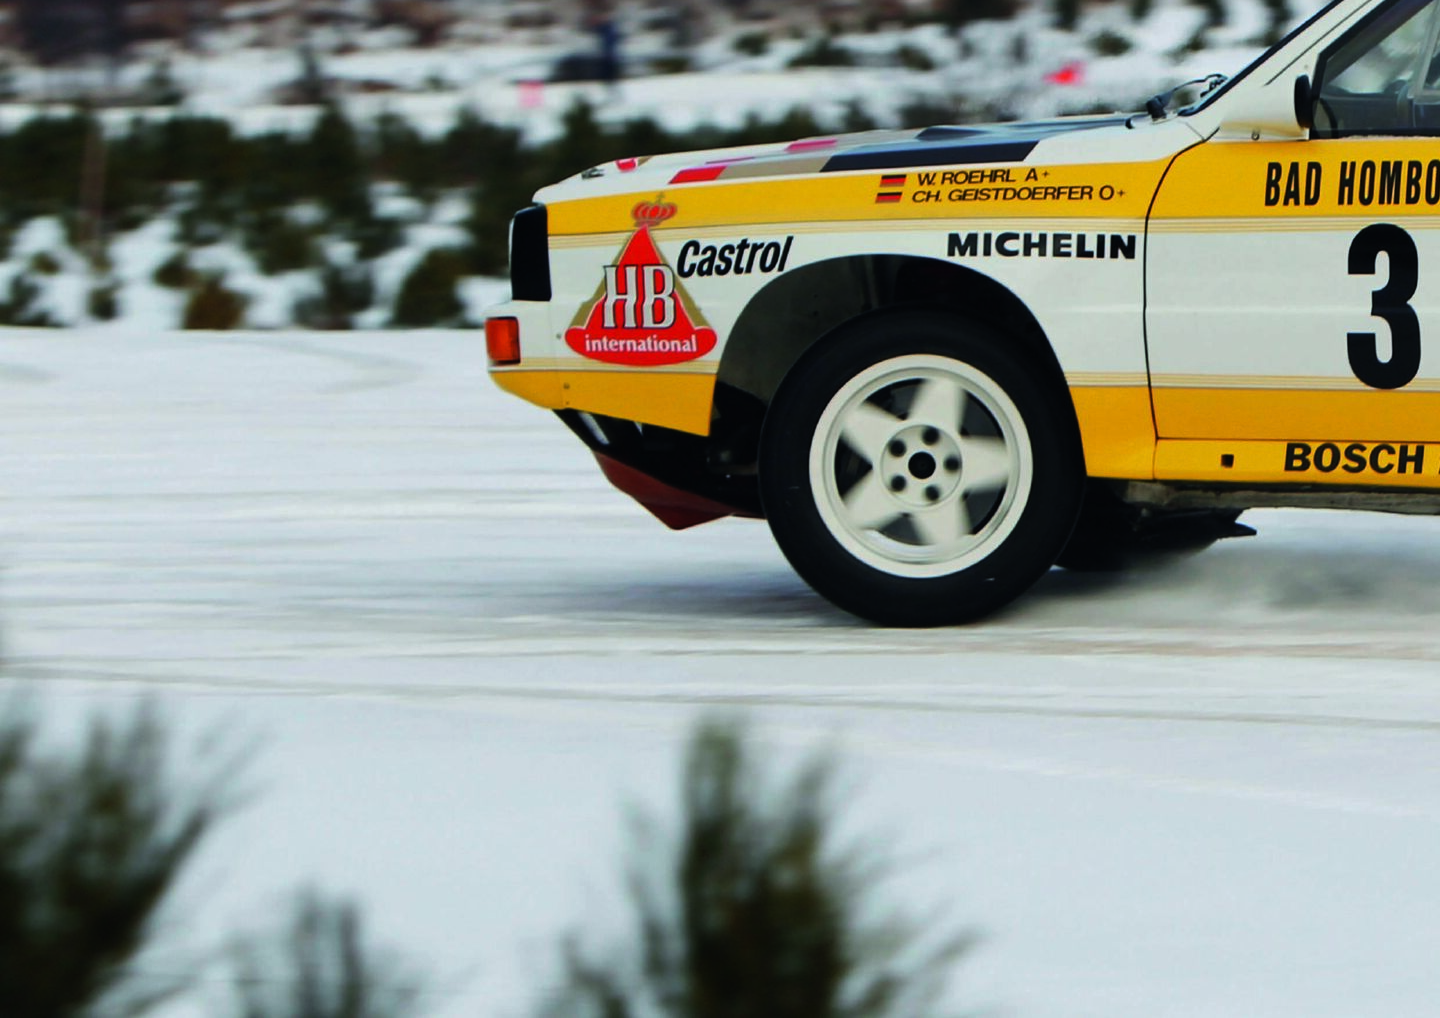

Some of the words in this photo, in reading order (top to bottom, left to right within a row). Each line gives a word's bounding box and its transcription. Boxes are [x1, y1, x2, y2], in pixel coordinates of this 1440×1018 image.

[917, 172, 936, 186] W.
[940, 169, 1017, 185] ROEHRL
[1264, 161, 1322, 207] BAD
[911, 190, 943, 203] CH.
[947, 185, 1093, 202] GEISTDOERFER
[677, 235, 794, 278] Castrol
[947, 232, 1136, 259] MICHELIN
[602, 264, 676, 330] HB
[1346, 222, 1422, 390] 3
[585, 333, 698, 353] international
[1284, 443, 1425, 474] BOSCH
